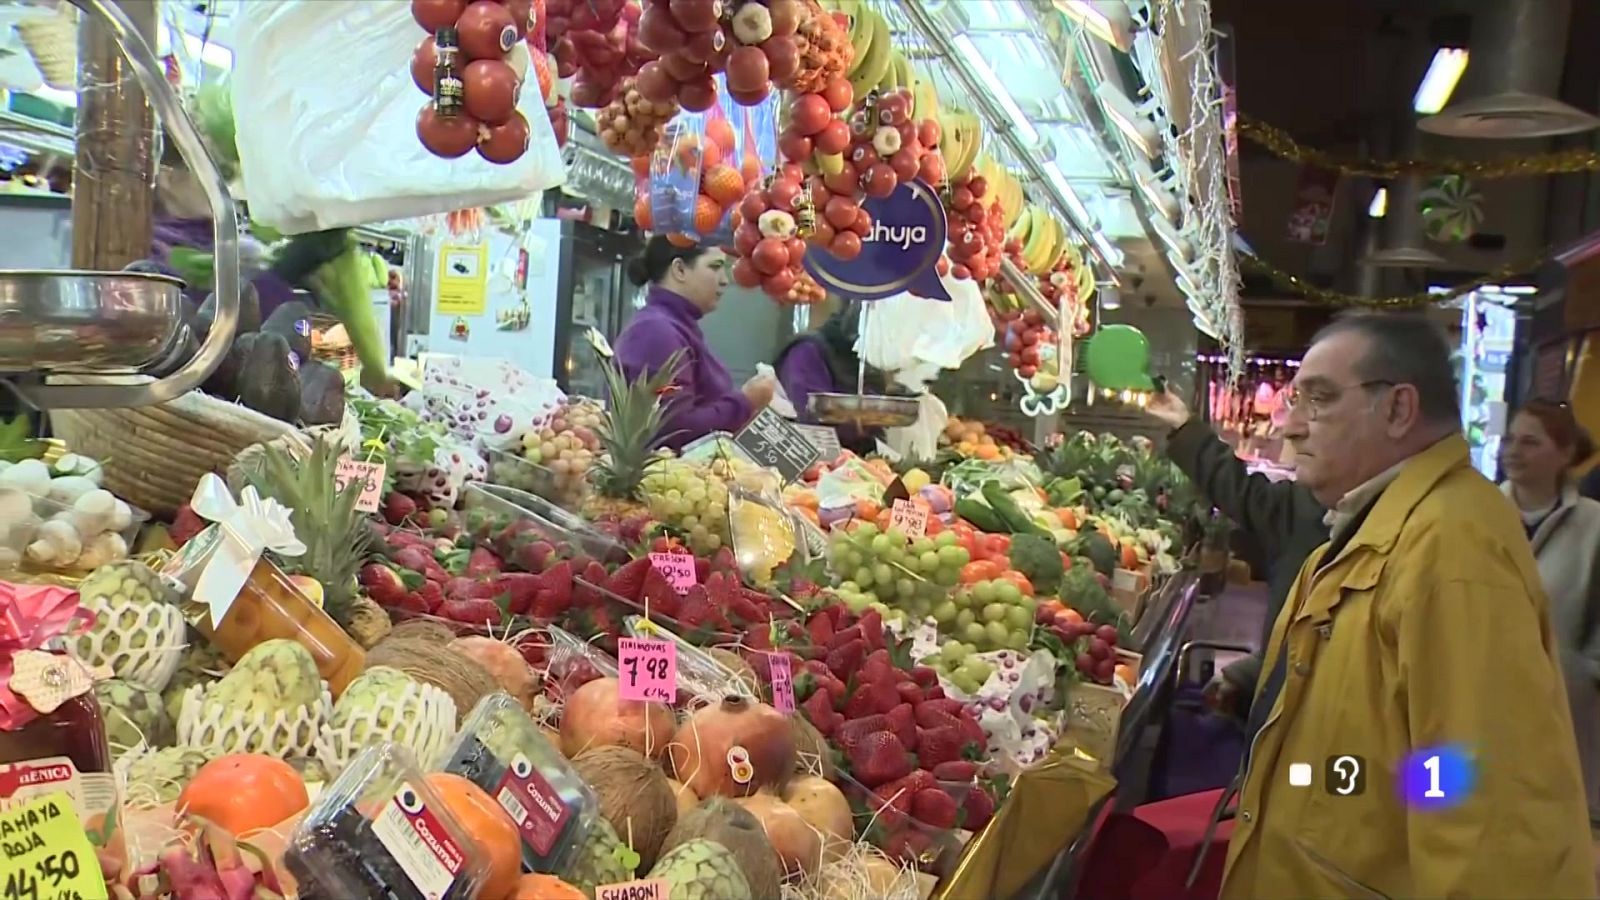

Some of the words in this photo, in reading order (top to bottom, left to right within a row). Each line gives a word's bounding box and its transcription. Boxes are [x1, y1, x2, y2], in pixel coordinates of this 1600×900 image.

[624, 656, 668, 686] 7'98
[527, 782, 561, 823] Cozumel
[2, 831, 46, 860] ROJA
[415, 818, 463, 873] Cozumel
